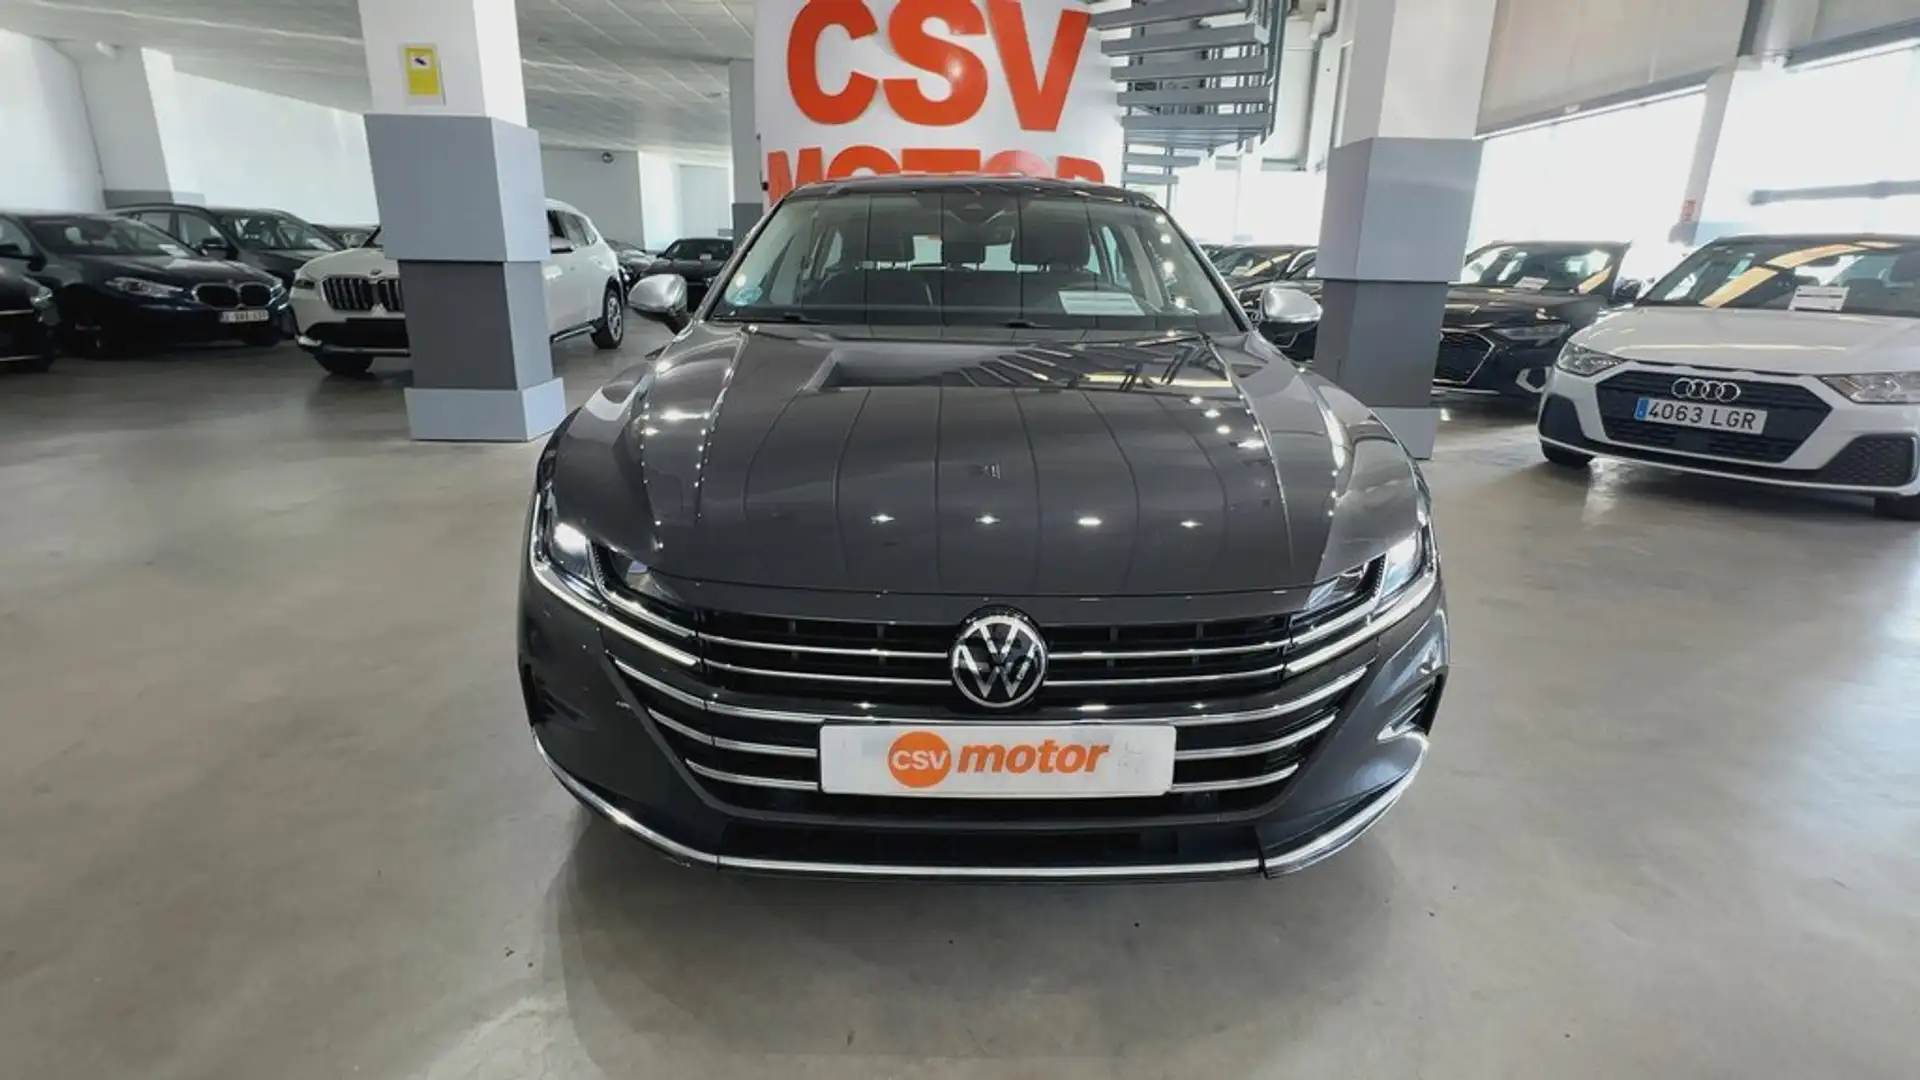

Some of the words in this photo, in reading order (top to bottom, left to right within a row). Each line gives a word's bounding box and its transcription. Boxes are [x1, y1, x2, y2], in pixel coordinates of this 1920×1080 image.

[787, 0, 1091, 131] CSV
[1648, 402, 1704, 424] 4063
[1710, 408, 1757, 430] LGR
[892, 750, 949, 770] CSV
[957, 739, 1110, 774] motor
